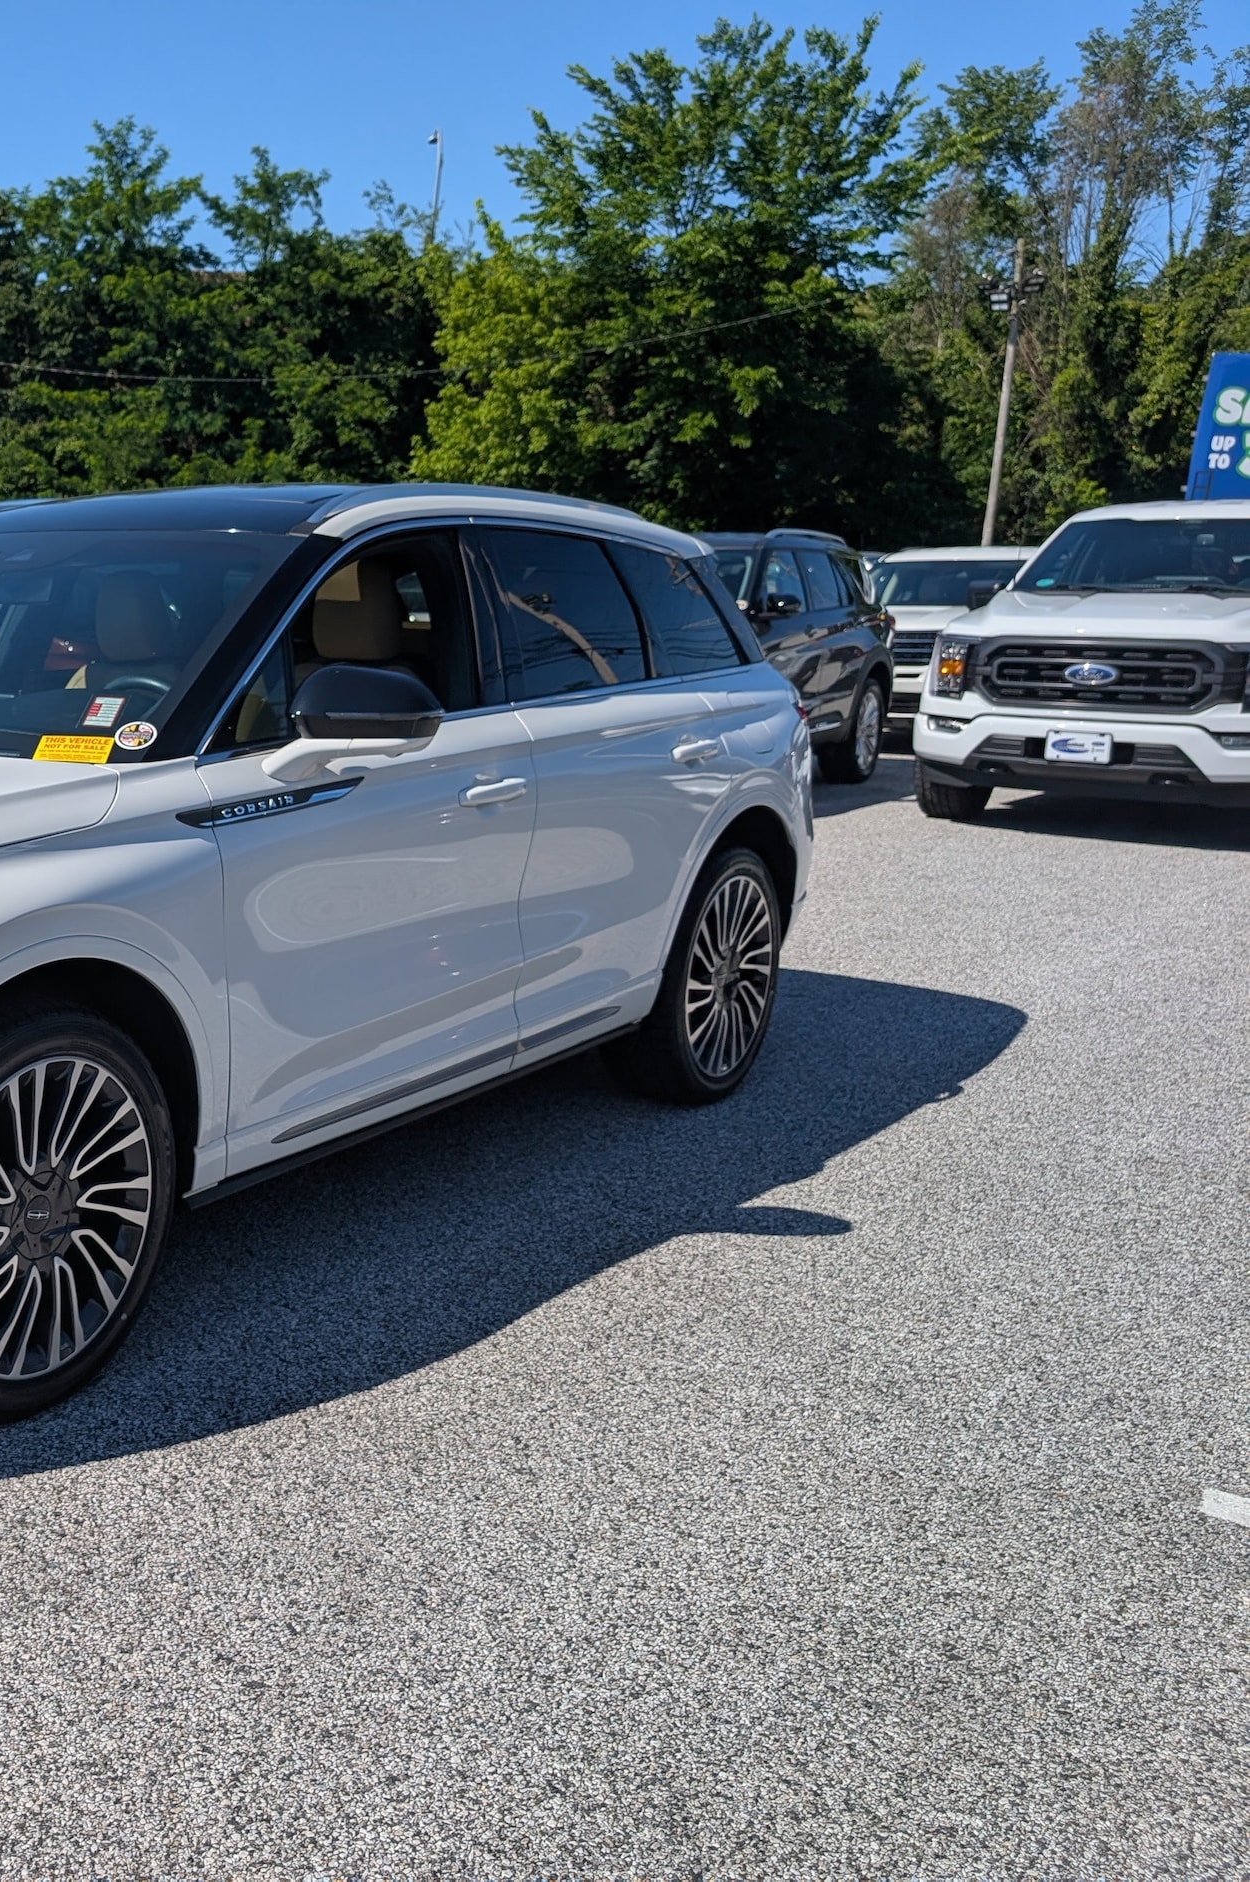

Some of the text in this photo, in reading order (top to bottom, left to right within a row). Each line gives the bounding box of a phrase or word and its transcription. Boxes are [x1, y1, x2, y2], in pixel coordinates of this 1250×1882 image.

[1211, 435, 1236, 452] UP
[1207, 453, 1231, 470] TO
[69, 737, 111, 746] VEHICLE
[221, 795, 294, 818] CORSAIR
